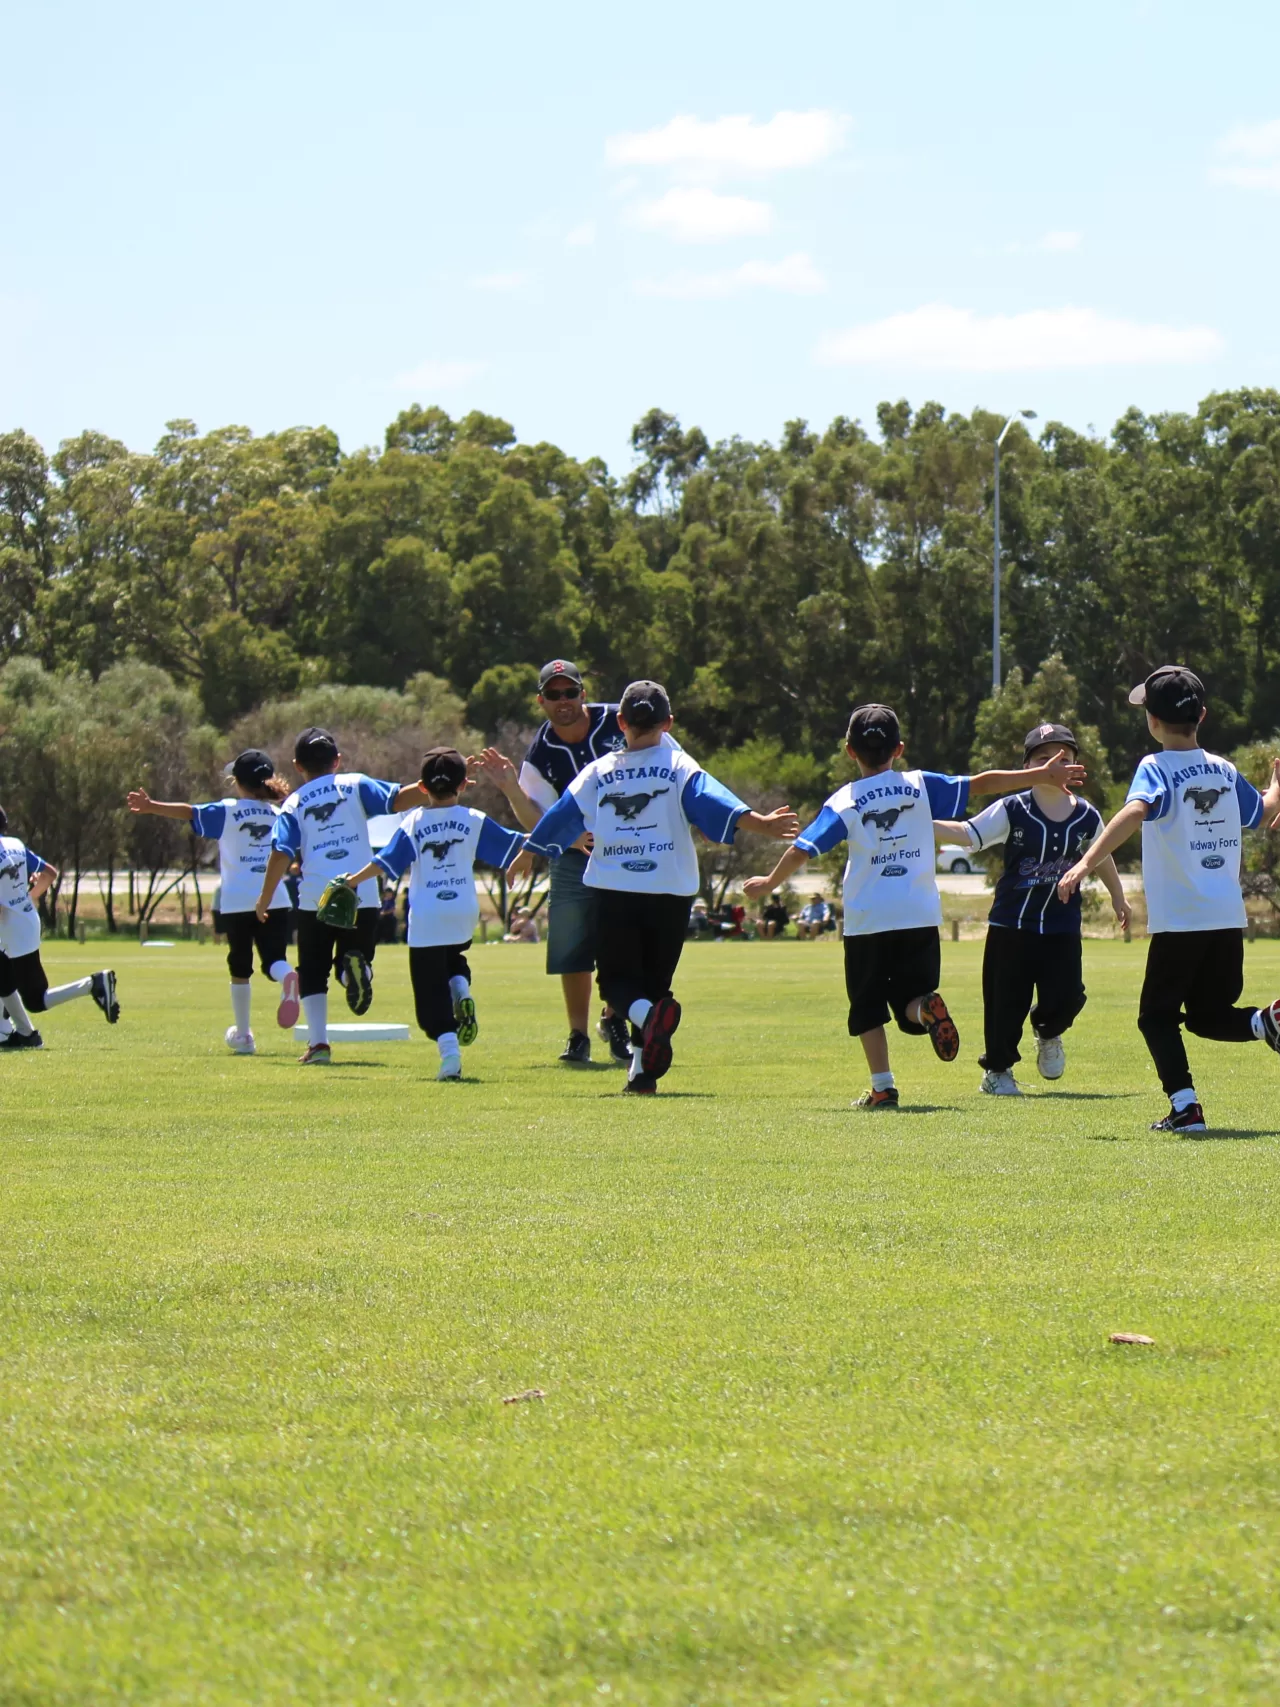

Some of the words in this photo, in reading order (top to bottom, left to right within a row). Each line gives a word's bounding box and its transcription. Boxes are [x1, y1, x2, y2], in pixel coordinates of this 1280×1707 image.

[852, 785, 921, 813] MUSTANGS
[232, 808, 277, 823] MUSTA
[413, 820, 471, 843] MUSTANGS
[603, 844, 646, 857] Midway
[649, 841, 674, 852] Ford
[899, 848, 920, 859] Ford
[1019, 856, 1075, 880] Eagle
